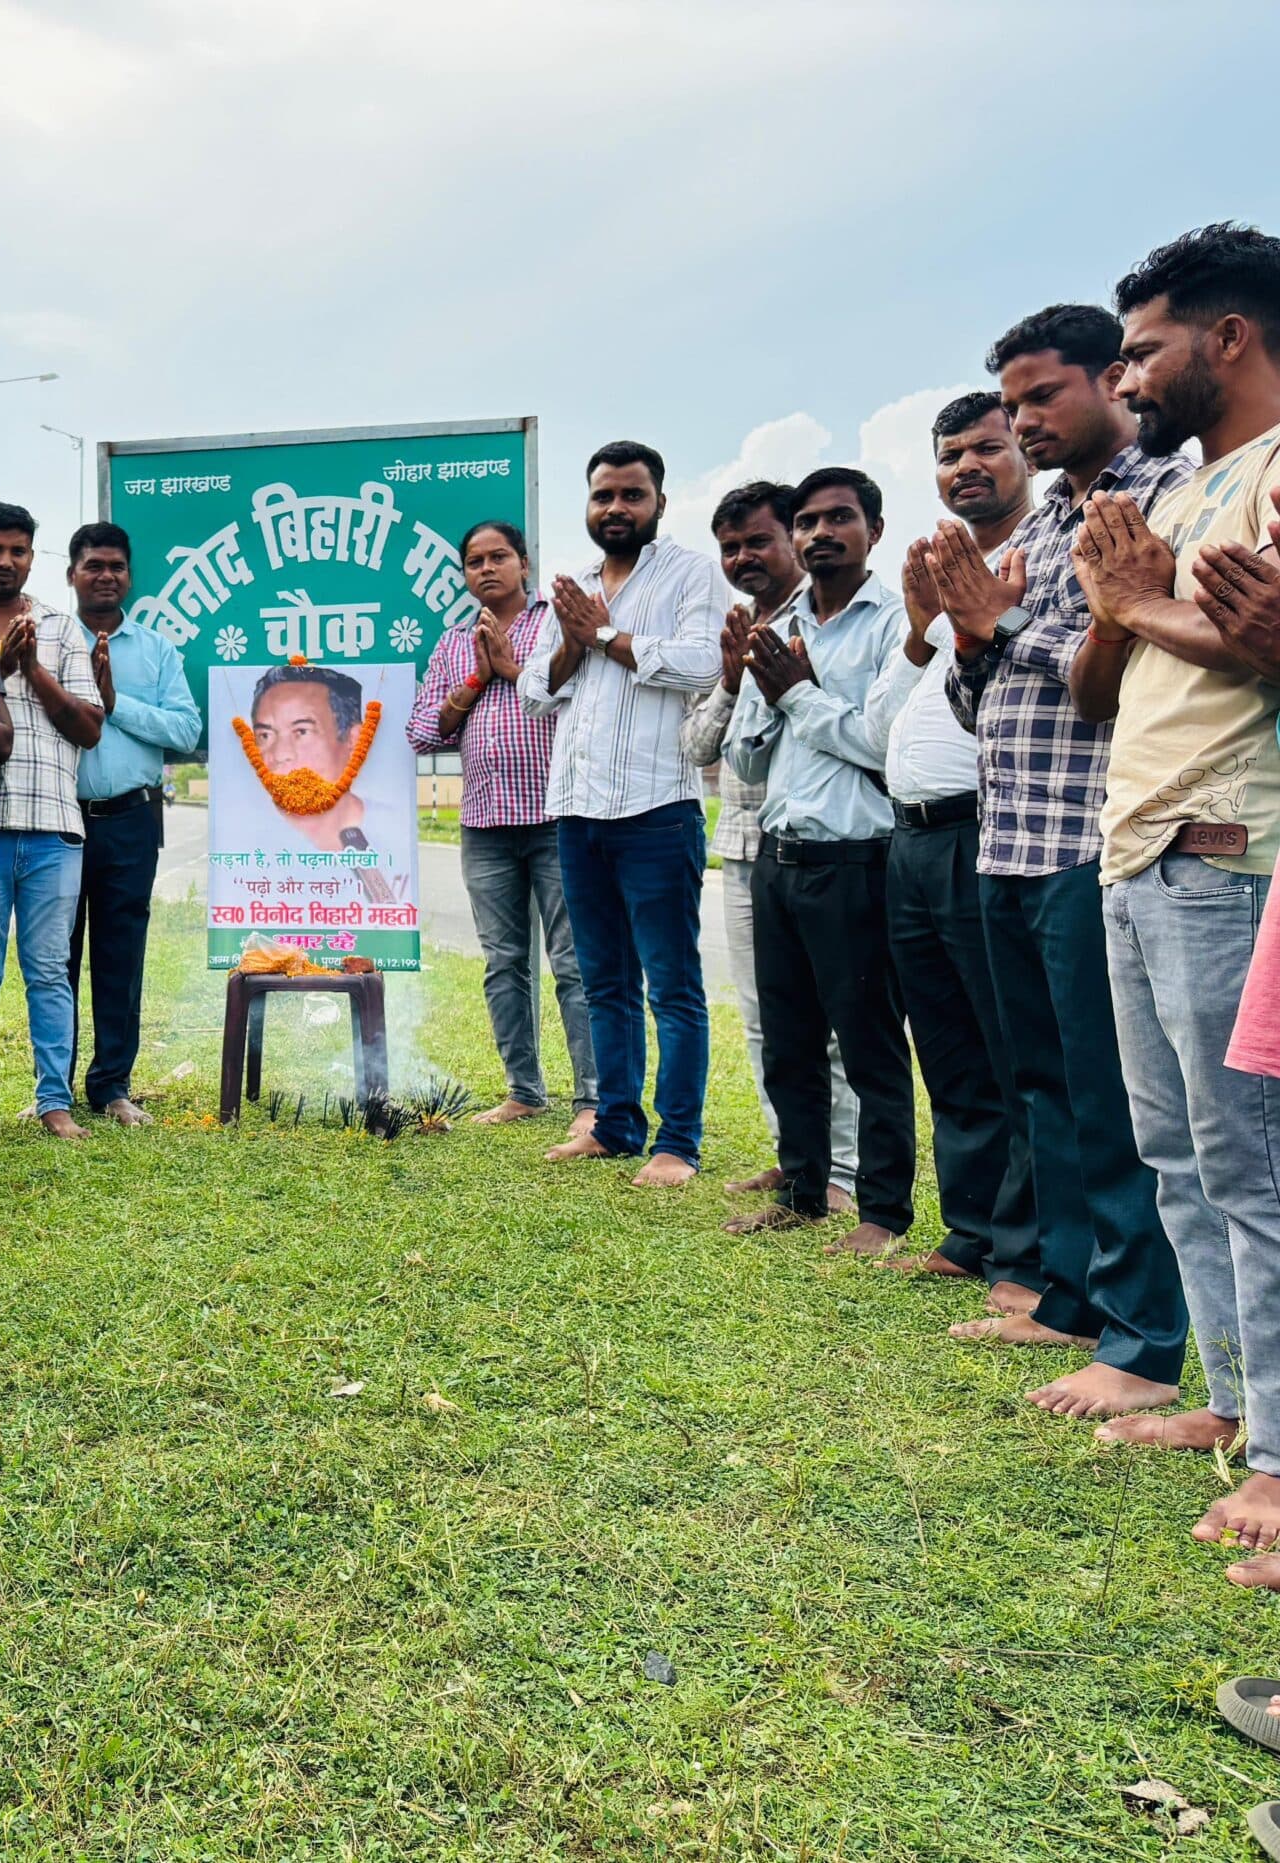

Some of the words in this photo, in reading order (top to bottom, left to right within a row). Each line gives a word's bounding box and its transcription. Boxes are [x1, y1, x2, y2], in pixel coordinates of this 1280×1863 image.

[382, 460, 432, 482] जोहार
[436, 458, 511, 482] झारखण्ड
[124, 478, 155, 495] जय
[160, 475, 232, 496] झारखण्ड
[251, 481, 403, 573] बिहारी
[259, 588, 382, 661] चौक
[208, 853, 250, 870] लड़ना
[275, 848, 292, 867] तो
[277, 876, 305, 894] और
[308, 901, 364, 925] बिहारी
[367, 902, 418, 925] महतो
[326, 930, 357, 951] रहे
